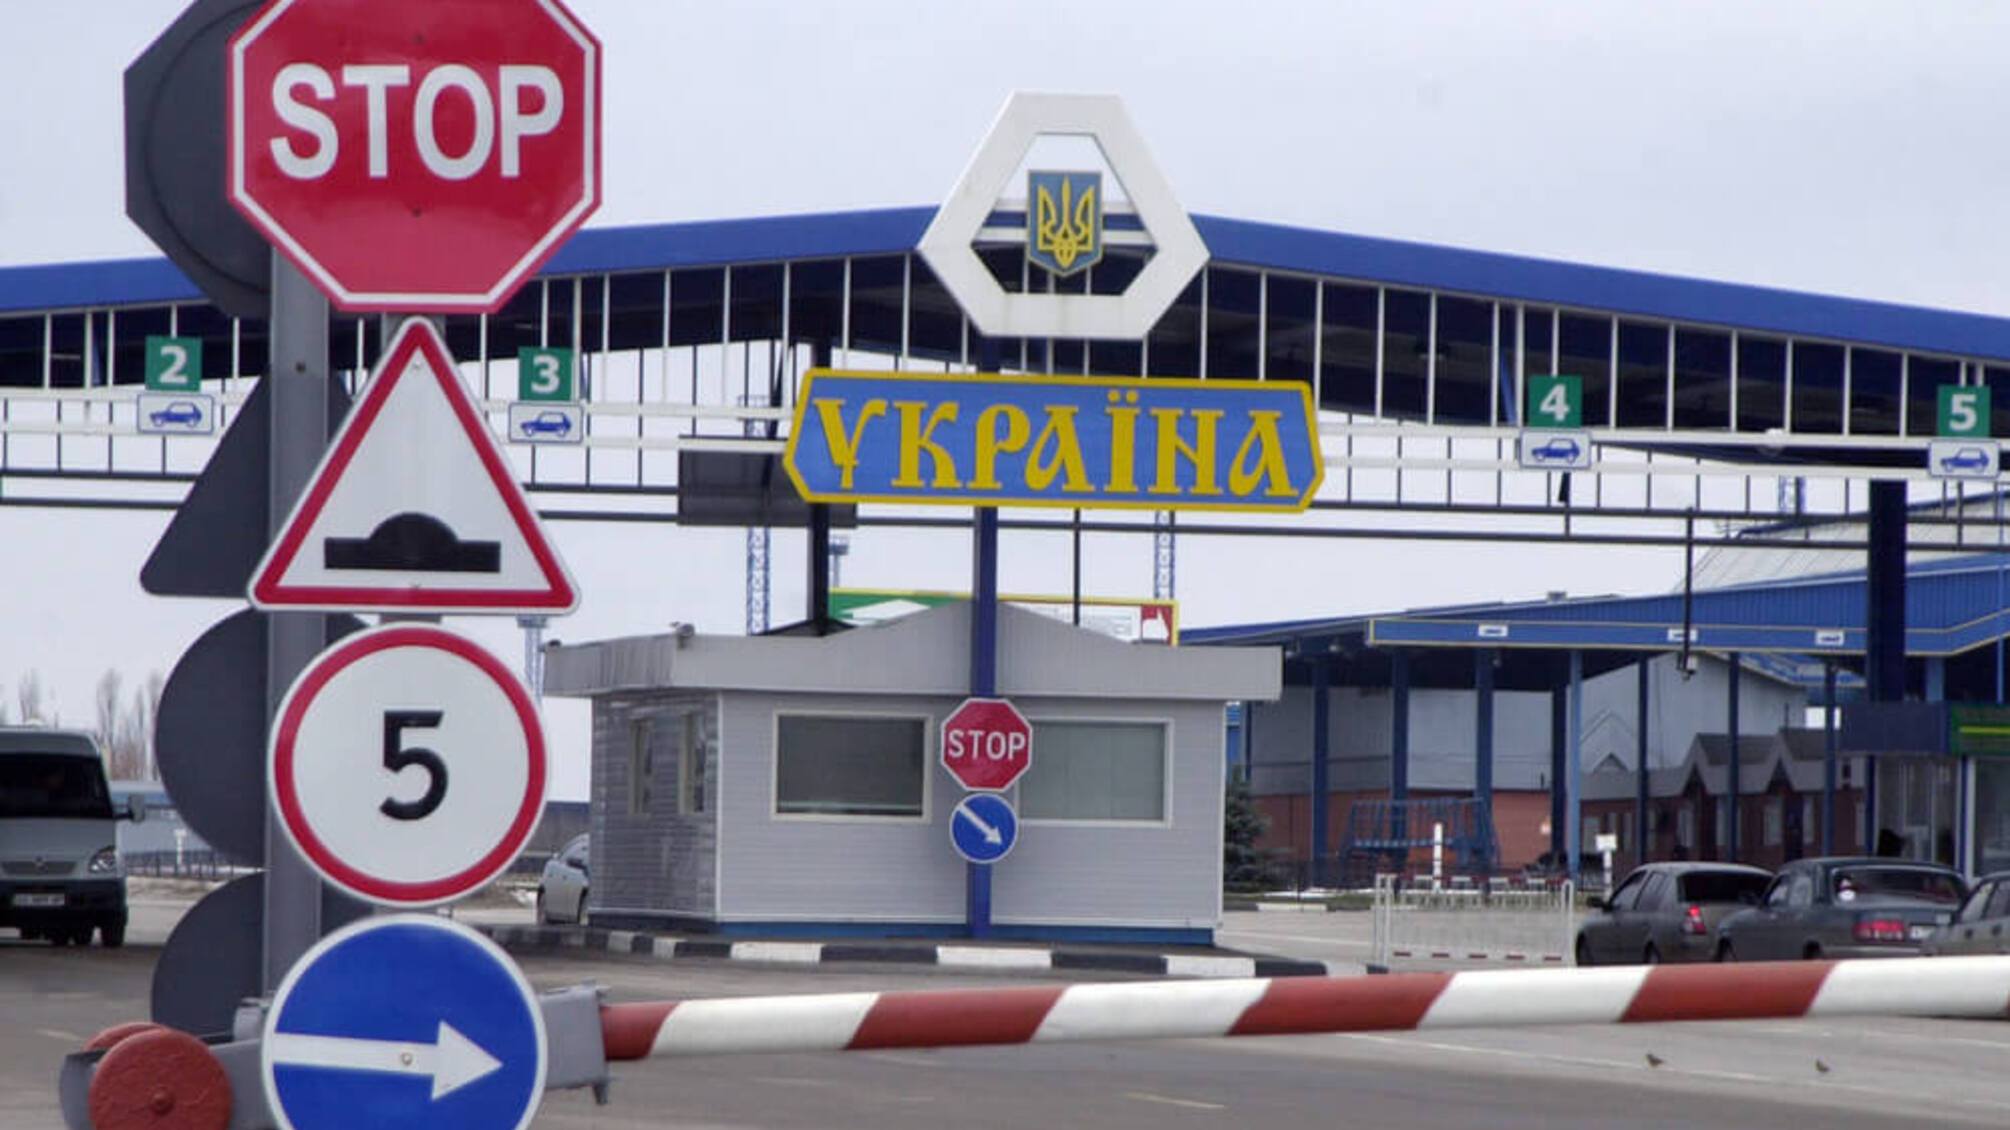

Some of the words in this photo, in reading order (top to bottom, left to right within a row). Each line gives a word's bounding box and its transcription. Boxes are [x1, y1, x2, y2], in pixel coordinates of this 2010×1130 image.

[269, 63, 565, 181] STOP
[157, 343, 188, 385] 2
[530, 353, 561, 395] 3
[1539, 384, 1571, 422] 4
[1949, 393, 1979, 432] 5
[812, 388, 1299, 498] УКРАЇНА
[379, 709, 450, 821] 5
[947, 728, 1028, 761] STOP
